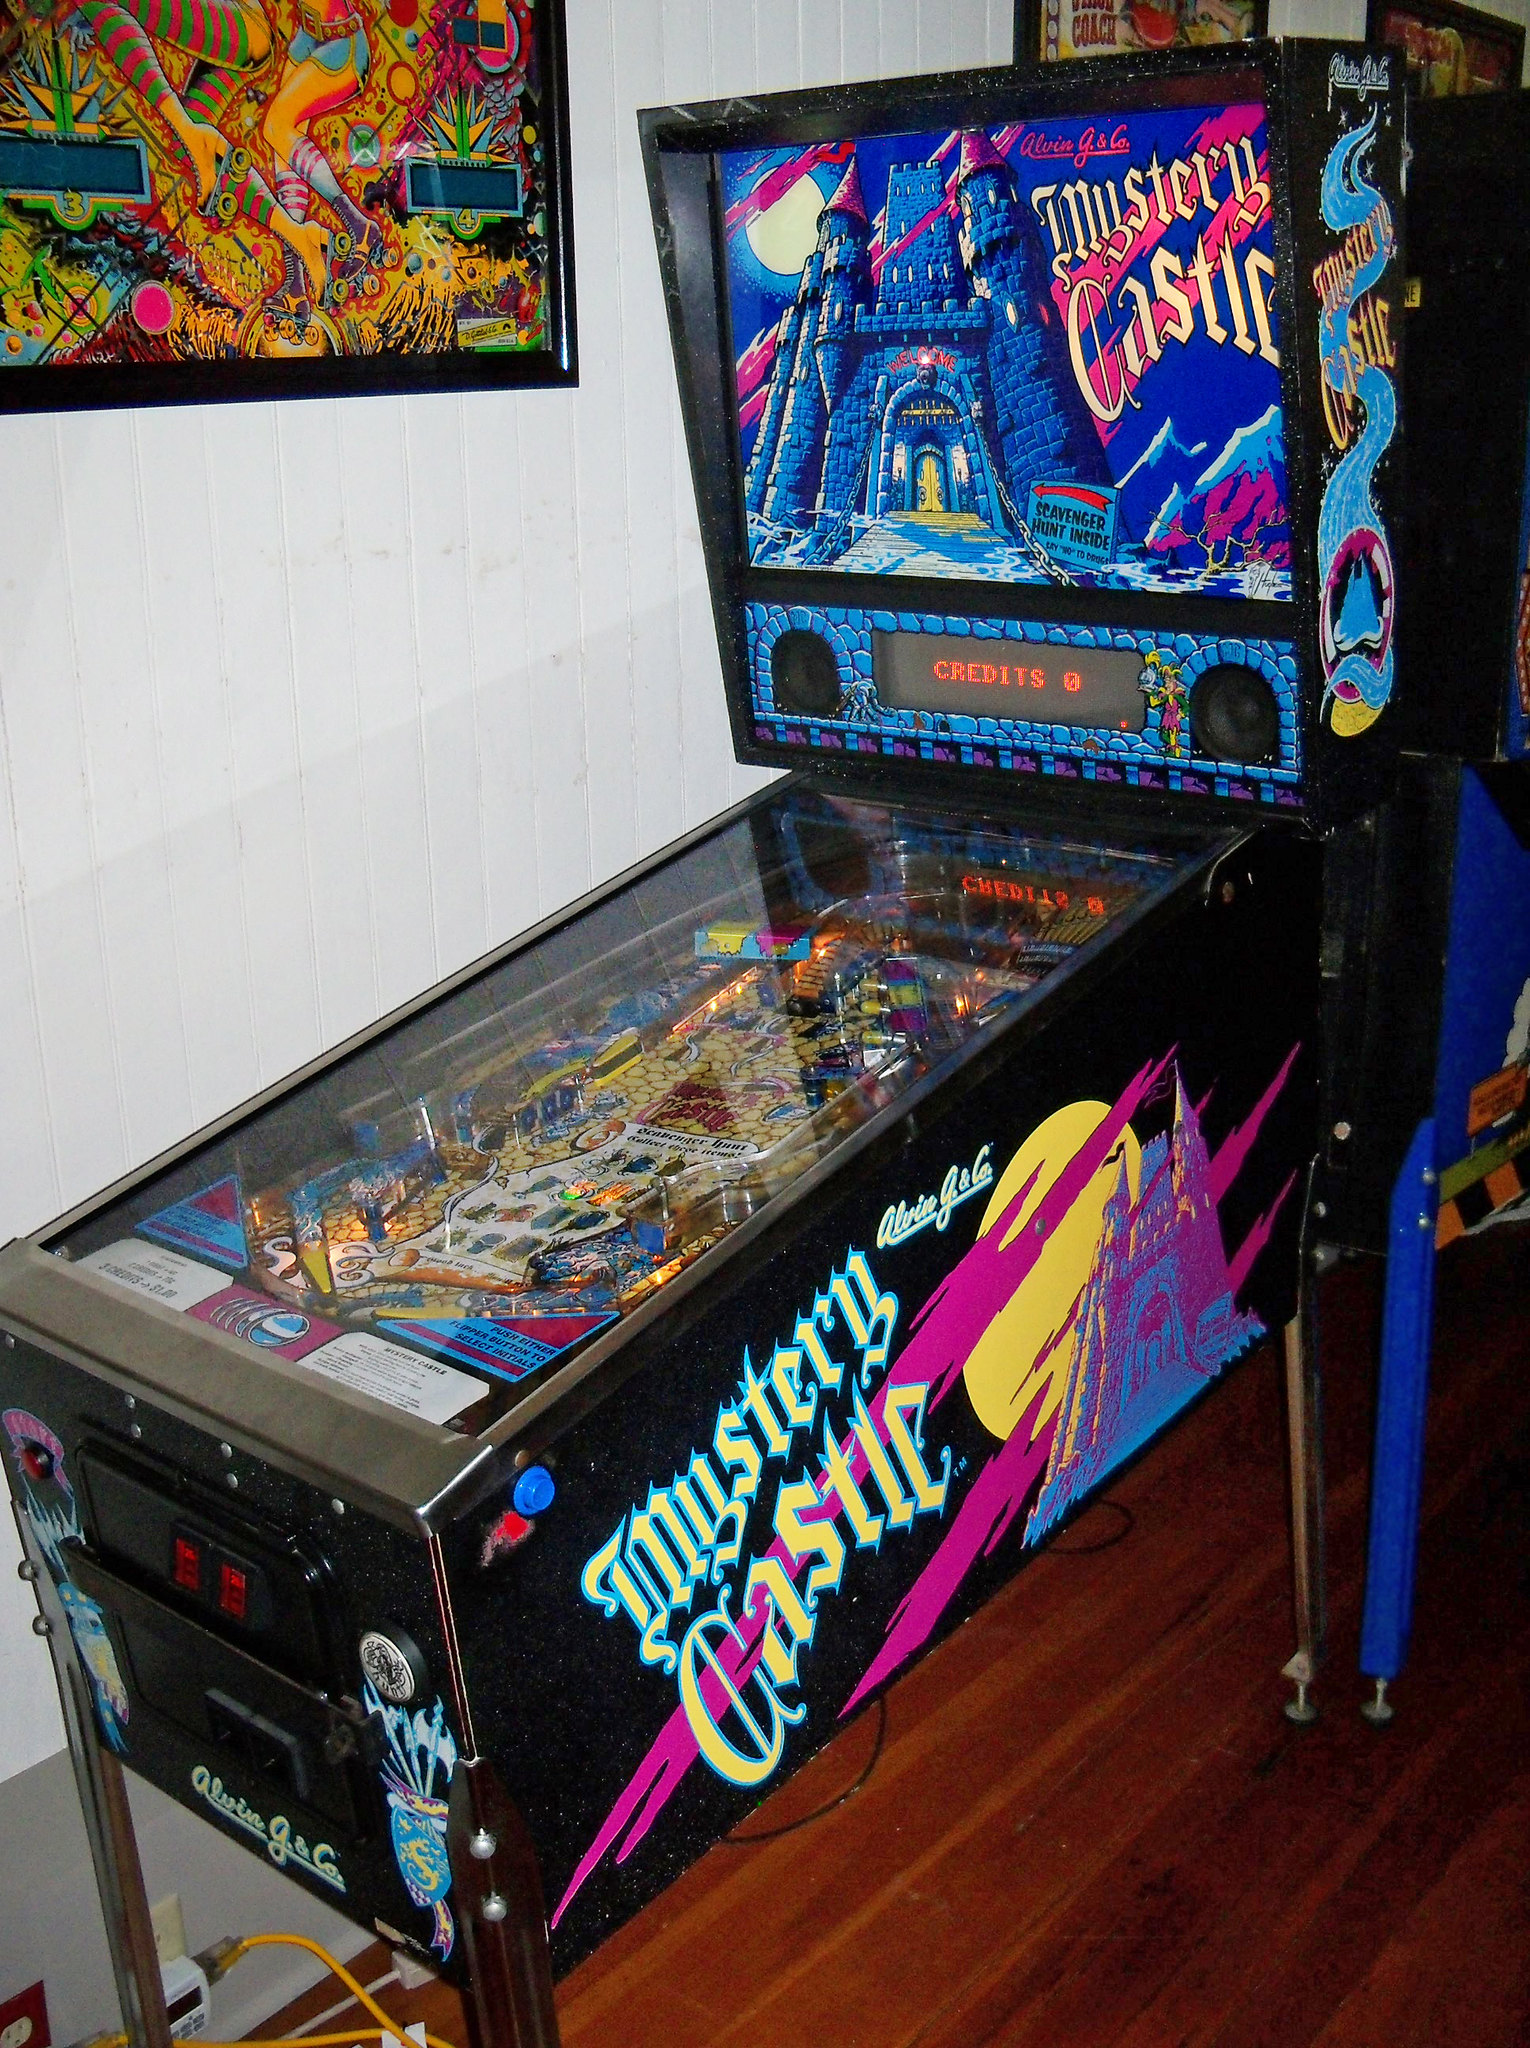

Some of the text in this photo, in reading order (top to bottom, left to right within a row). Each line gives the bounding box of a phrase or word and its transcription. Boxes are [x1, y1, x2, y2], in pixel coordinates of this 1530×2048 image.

[1072, 13, 1117, 48] COACH
[1020, 124, 1130, 168] Alvin G. & Co.
[63, 191, 84, 217] 3
[457, 208, 475, 229] 4
[1031, 136, 1271, 291] Mystery
[1313, 198, 1394, 337] Mystery
[1068, 229, 1280, 422] Castle
[886, 346, 959, 374] WELCOME
[1035, 501, 1106, 532] SCAVENGER
[1032, 518, 1111, 551] HUNT INSIDE
[1045, 541, 1059, 552] SAY
[1076, 549, 1086, 559] TO
[933, 660, 1081, 692] CREDITS 0
[627, 1135, 668, 1149] Collect
[637, 1127, 748, 1152] Scavenger Hunt
[877, 1144, 993, 1249] Alvin G. & Co.
[449, 1320, 546, 1362] FLIPPER BUTTON TO
[455, 1333, 537, 1370] SELECT INITIALS
[490, 1326, 557, 1356] PUSH EITHER
[383, 1346, 448, 1376] MYSTERY CASTLE
[581, 1246, 898, 1672] Mystery
[678, 1375, 951, 1784] Castle
[191, 1765, 345, 1885] Alvin G. & Co.
